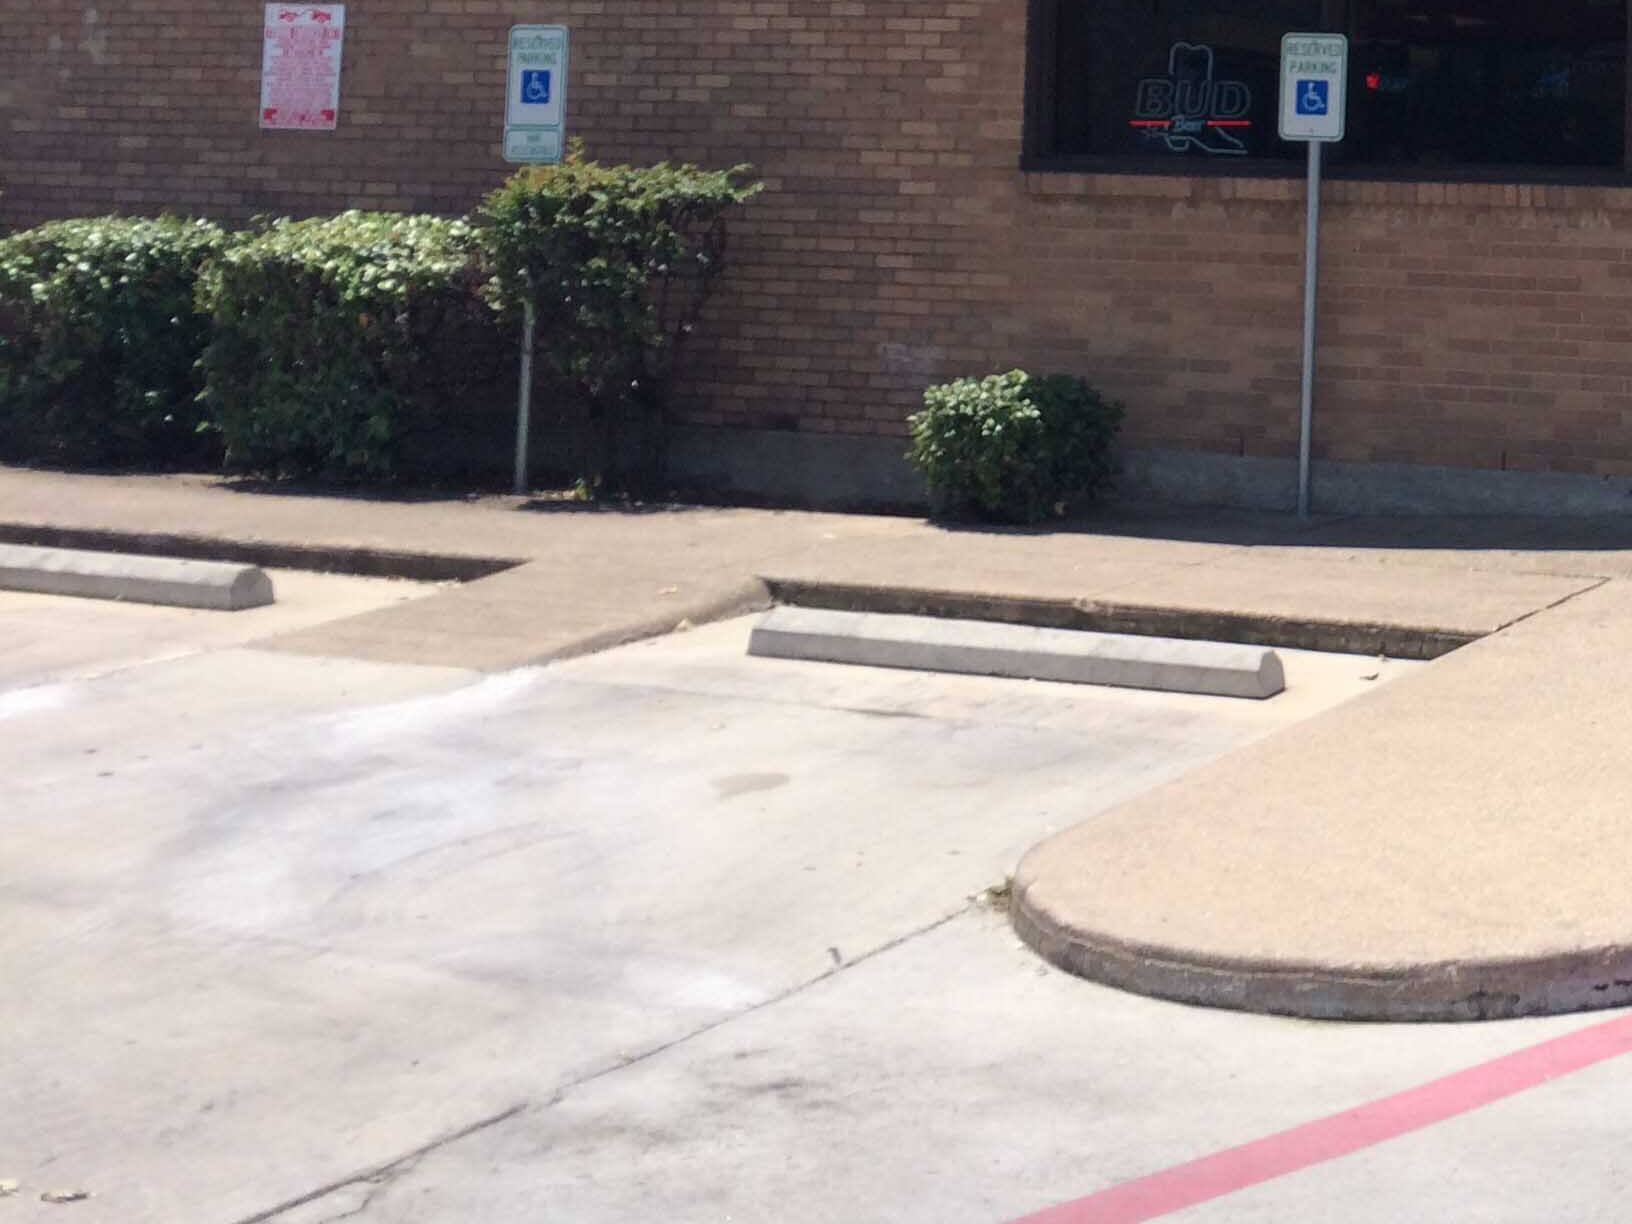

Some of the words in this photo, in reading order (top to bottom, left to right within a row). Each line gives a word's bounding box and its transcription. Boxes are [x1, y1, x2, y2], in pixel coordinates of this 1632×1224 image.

[1287, 42, 1343, 56] RESERVED
[1288, 61, 1337, 73] PARKING
[1136, 79, 1251, 119] BUD
